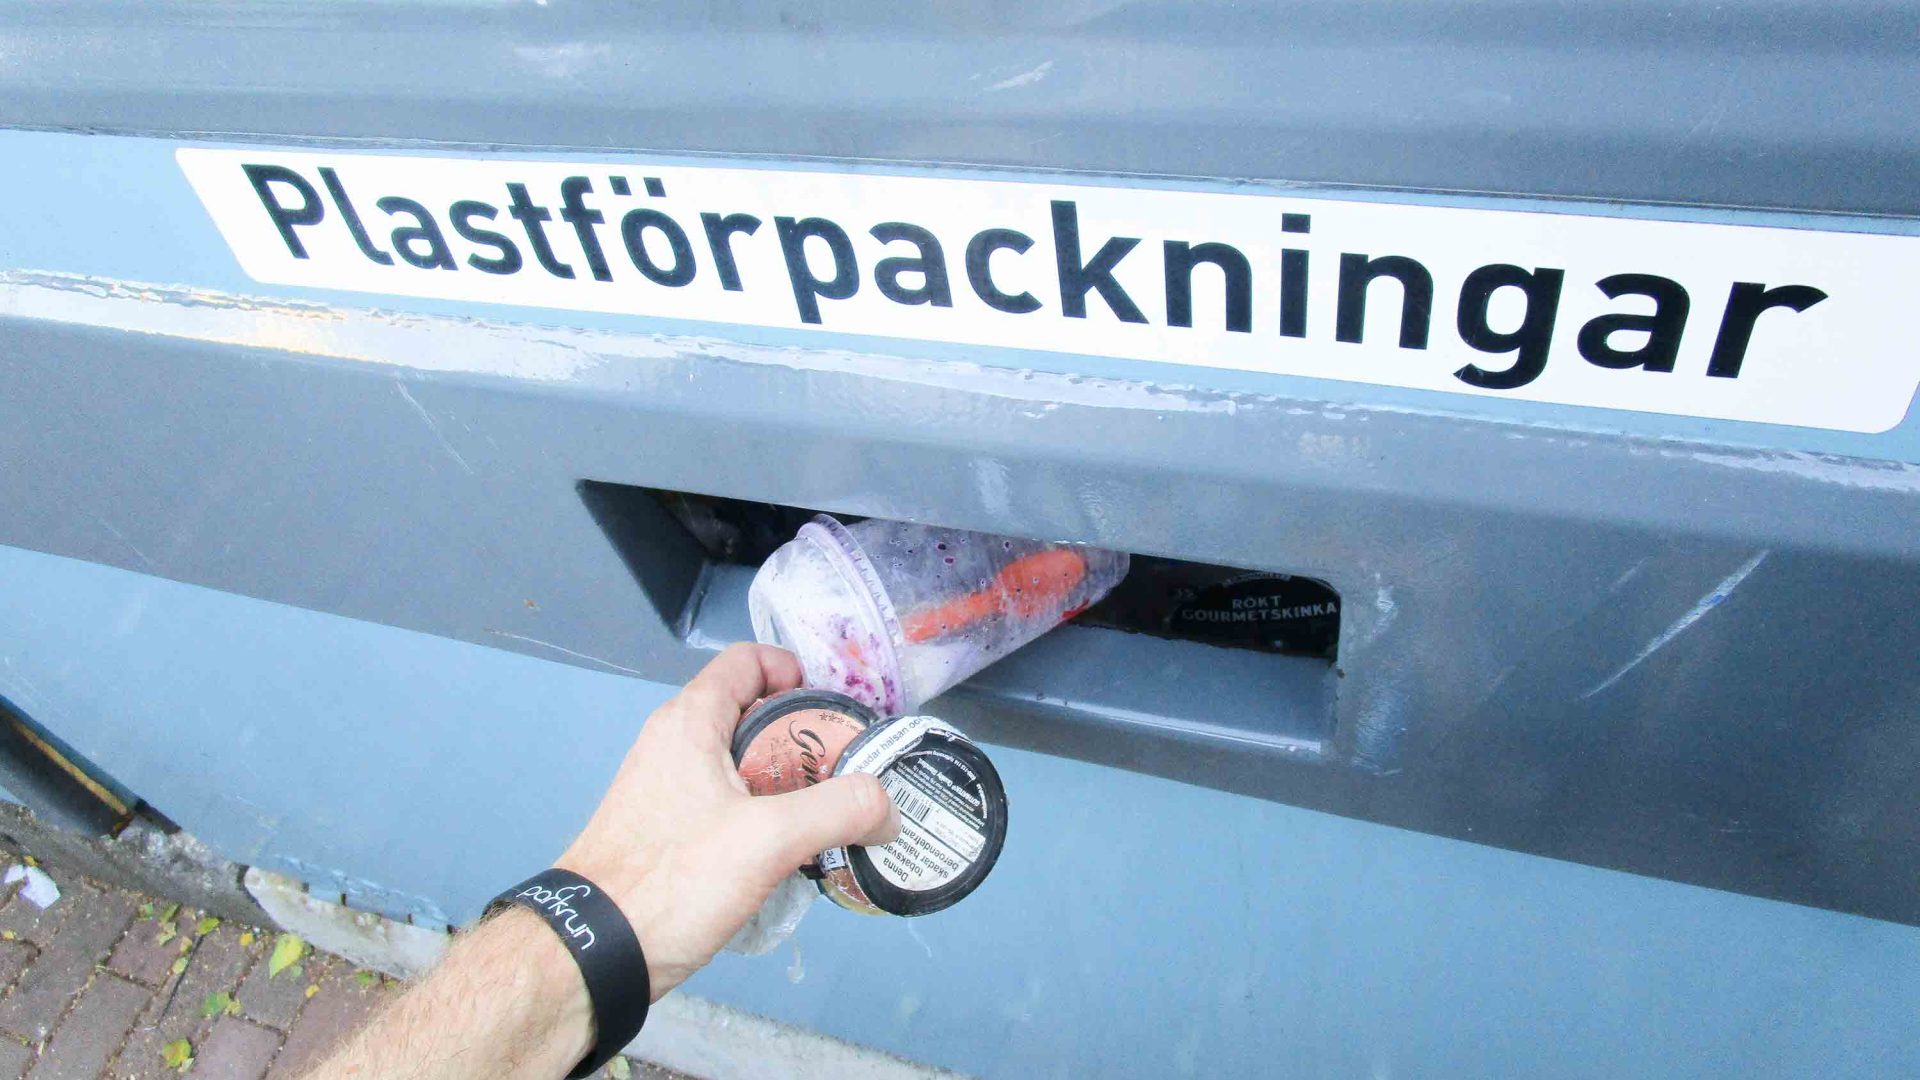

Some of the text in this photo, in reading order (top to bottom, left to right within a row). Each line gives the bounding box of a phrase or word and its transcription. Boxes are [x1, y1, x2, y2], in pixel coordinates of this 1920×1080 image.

[241, 163, 1828, 390] Plastförpackningar
[1182, 602, 1337, 622] GOURMETSKINKA
[900, 823, 960, 872] beroendefram
[883, 857, 909, 882] Denna
[920, 855, 949, 879] skadar
